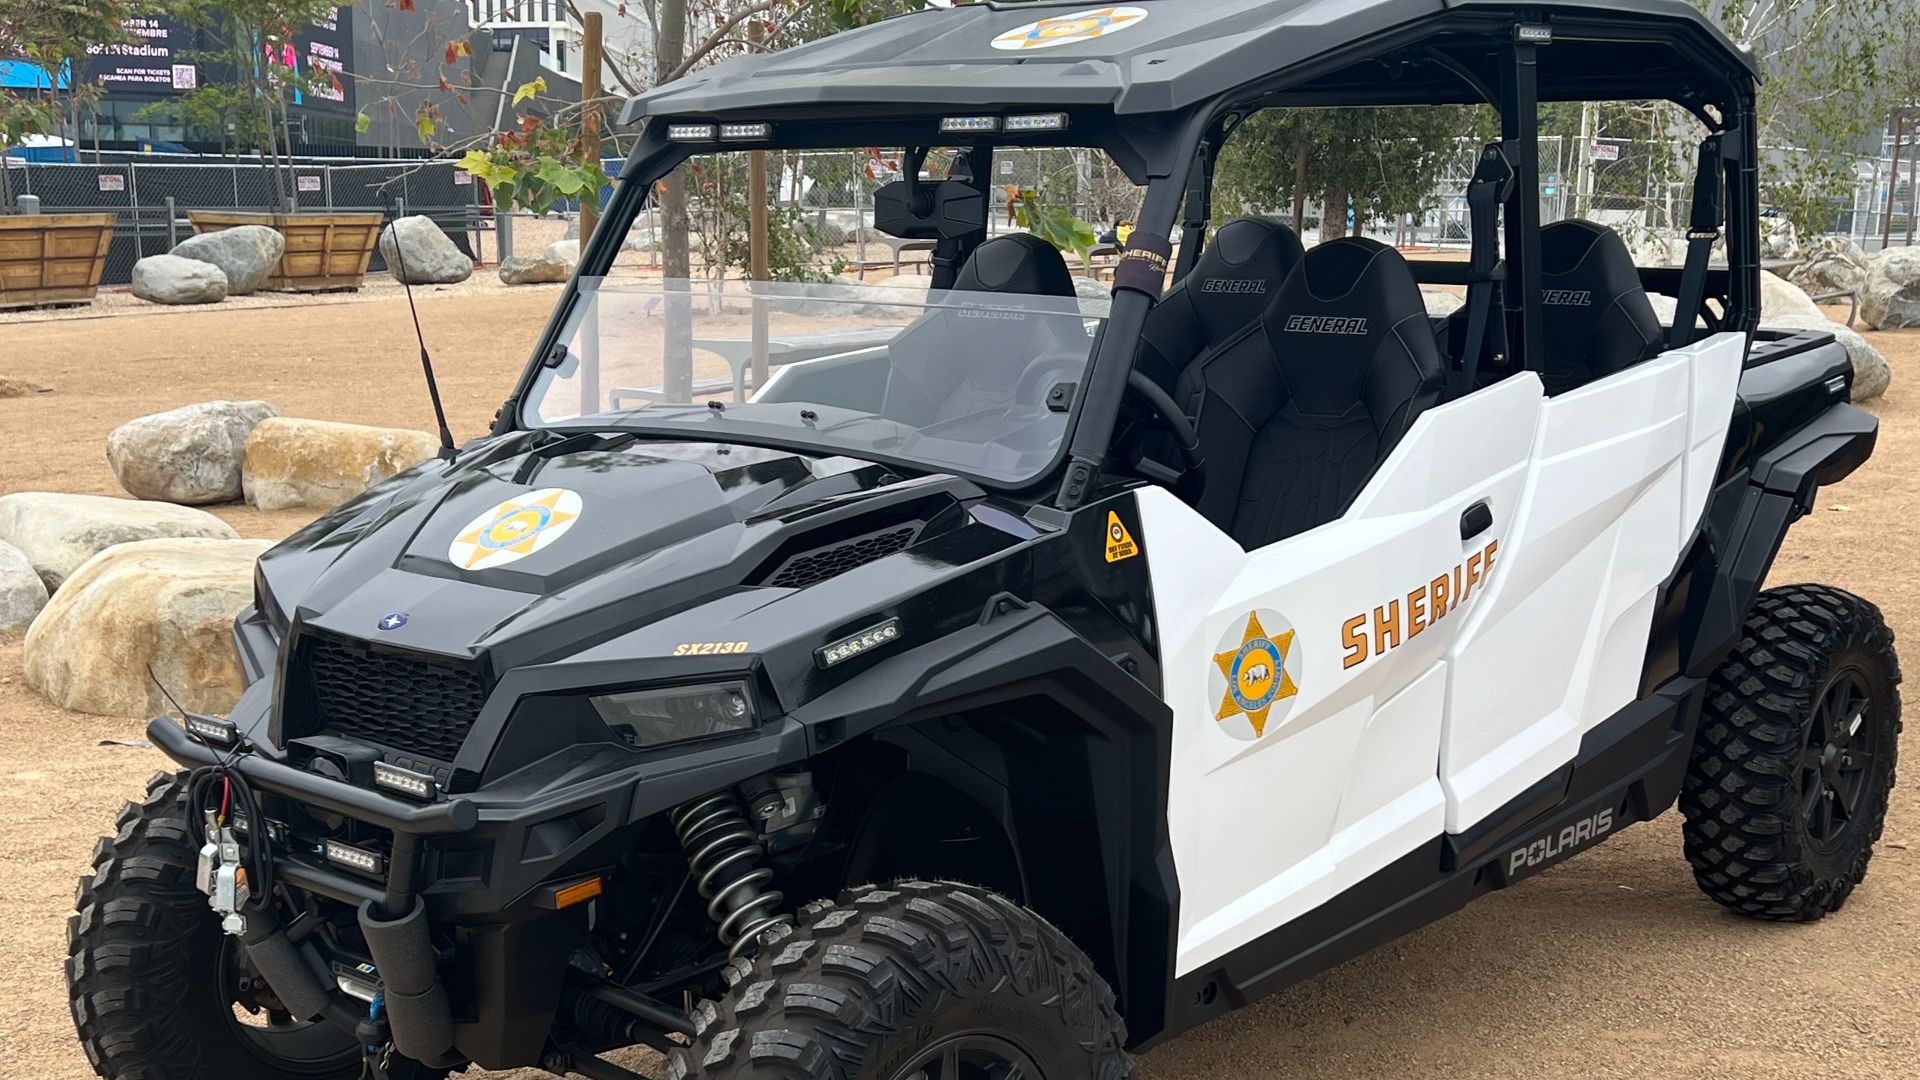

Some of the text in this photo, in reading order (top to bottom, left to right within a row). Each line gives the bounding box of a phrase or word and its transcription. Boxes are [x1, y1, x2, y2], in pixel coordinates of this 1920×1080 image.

[149, 20, 159, 28] 14
[121, 44, 169, 57] Stadium
[116, 67, 133, 75] SCAN
[1201, 278, 1267, 294] GENERAL
[1283, 314, 1369, 335] GENERAL
[1341, 538, 1499, 671] SHERIFF
[673, 641, 749, 656] SX2130
[1509, 807, 1614, 877] POLARIS
